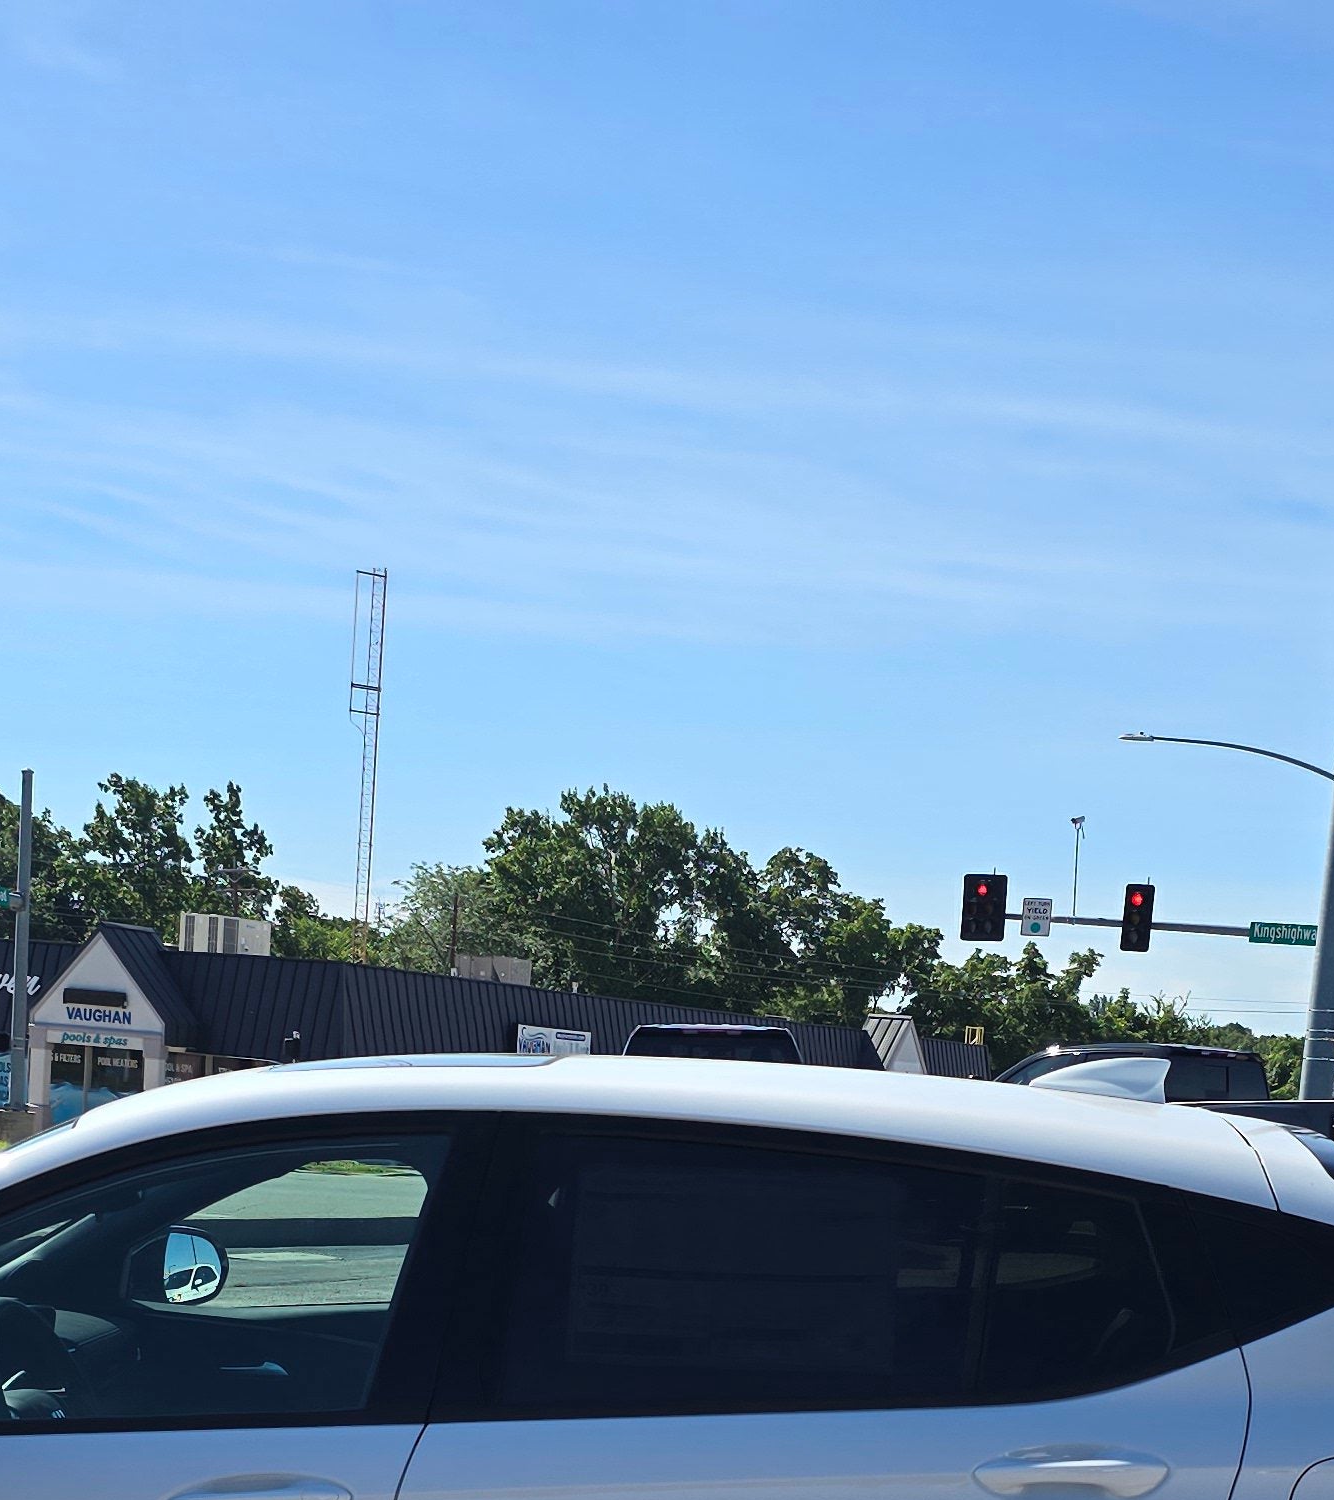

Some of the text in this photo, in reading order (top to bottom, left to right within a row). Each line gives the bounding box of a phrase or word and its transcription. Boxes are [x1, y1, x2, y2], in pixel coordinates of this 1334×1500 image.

[1253, 922, 1317, 943] Kingshighwa
[66, 1006, 131, 1025] VAUGHAN
[61, 1032, 129, 1048] pools & spas
